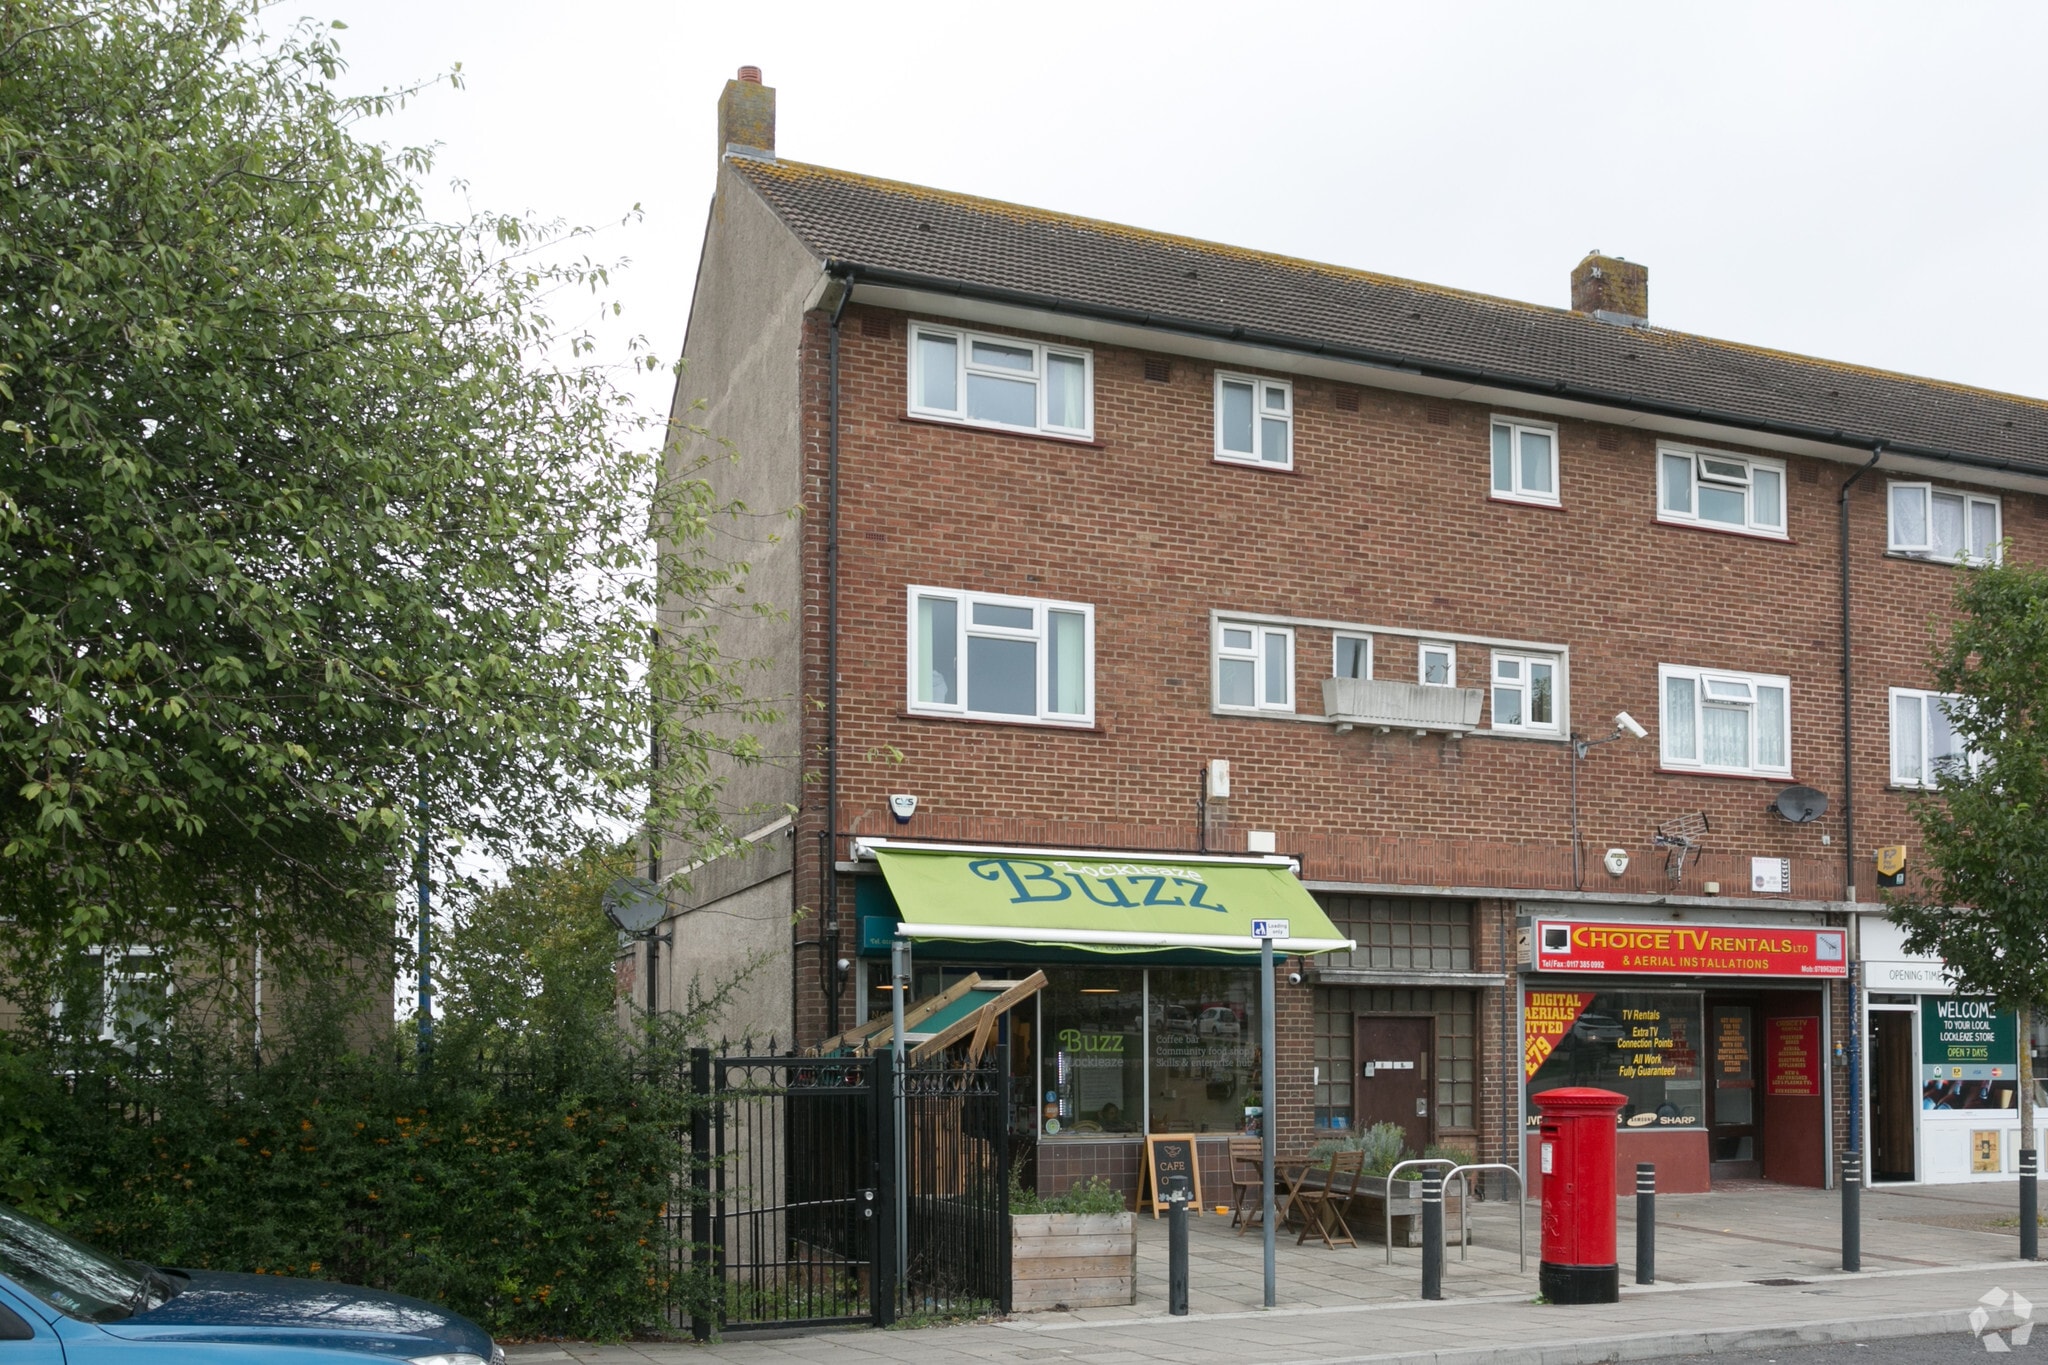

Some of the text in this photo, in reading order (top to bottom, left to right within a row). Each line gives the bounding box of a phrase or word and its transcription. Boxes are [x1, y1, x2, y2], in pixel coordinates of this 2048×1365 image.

[1053, 861, 1204, 882] Lockleaze
[968, 859, 1228, 913] Buzz
[1572, 927, 1808, 953] CHOICE TV RENTALS LTD
[1622, 955, 1769, 970] & AERIAL INSTALLATIONS
[1889, 969, 1941, 981] OPENING TIME
[1532, 993, 1581, 1007] DIGITAL
[1525, 1007, 1575, 1020] AERIALS
[1623, 1010, 1660, 1020] TV Rentals
[1526, 1021, 1564, 1034] ITTED
[1944, 1020, 1991, 1030] TO YOUR LOCAL
[1632, 1027, 1658, 1037] Extra TV
[1974, 1032, 1995, 1042] STORE
[1059, 1029, 1124, 1052] Buzz
[1156, 1034, 1200, 1044] Coffee bar
[1617, 1038, 1674, 1048] Connection Points
[1156, 1046, 1250, 1057] Community food shop
[1947, 1048, 1988, 1057] OPEN 7 DAYS
[1156, 1058, 1252, 1068] Skills & enterprise hub
[1633, 1054, 1662, 1064] All Work
[1619, 1065, 1676, 1078] Fully Guaranteed
[1660, 1116, 1695, 1125] SHARP
[1160, 1161, 1185, 1171] CAFE
